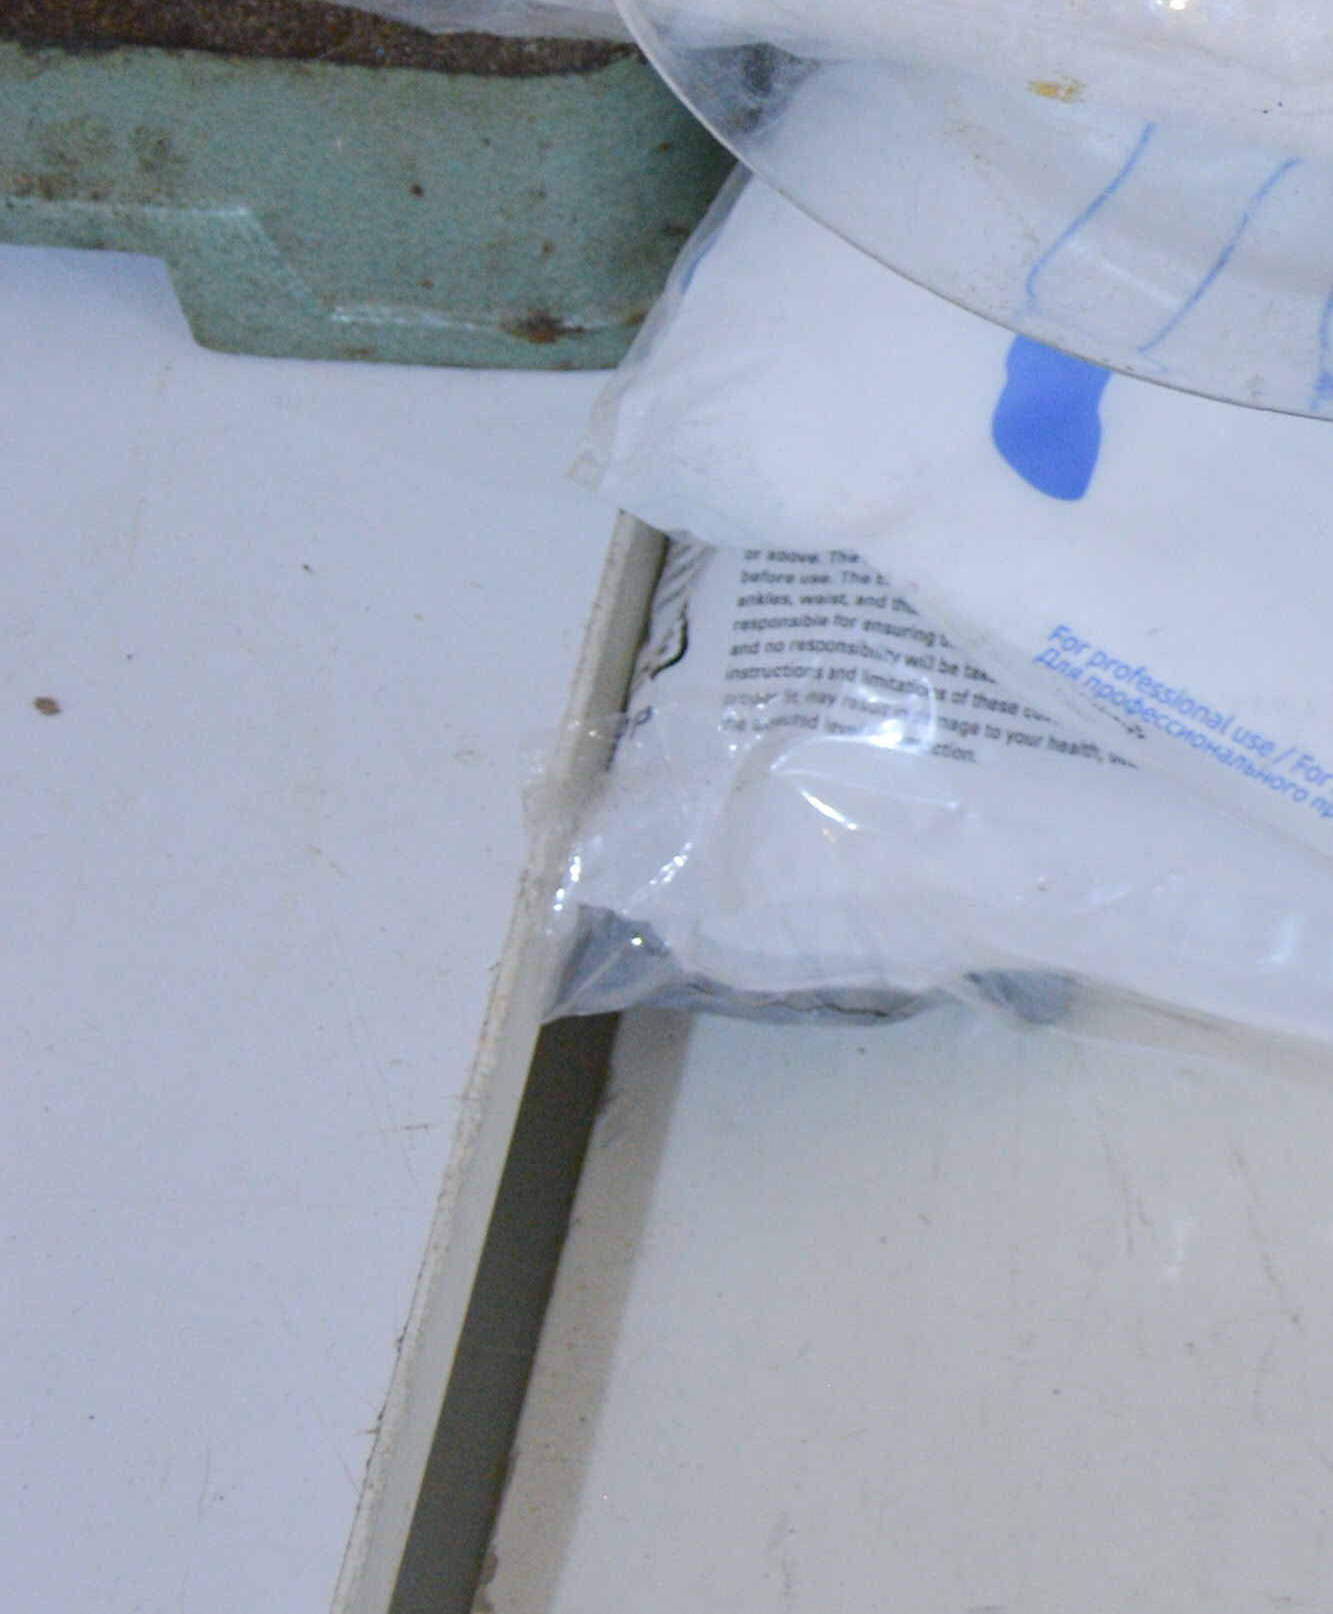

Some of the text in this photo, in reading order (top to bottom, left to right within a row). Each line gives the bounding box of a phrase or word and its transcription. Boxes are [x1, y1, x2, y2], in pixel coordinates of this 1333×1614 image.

[854, 593, 887, 608] and
[732, 613, 829, 632] responsible
[834, 613, 857, 629] for
[862, 618, 936, 647] ensuring
[729, 641, 761, 657] and
[938, 657, 959, 676] be
[951, 686, 970, 705] of
[971, 693, 1019, 717] these
[1047, 623, 1092, 655] For
[1086, 648, 1235, 736] professional
[1232, 723, 1278, 759] use
[1005, 728, 1044, 749] your
[1033, 646, 1083, 682] Для
[1083, 672, 1310, 804] профессионального
